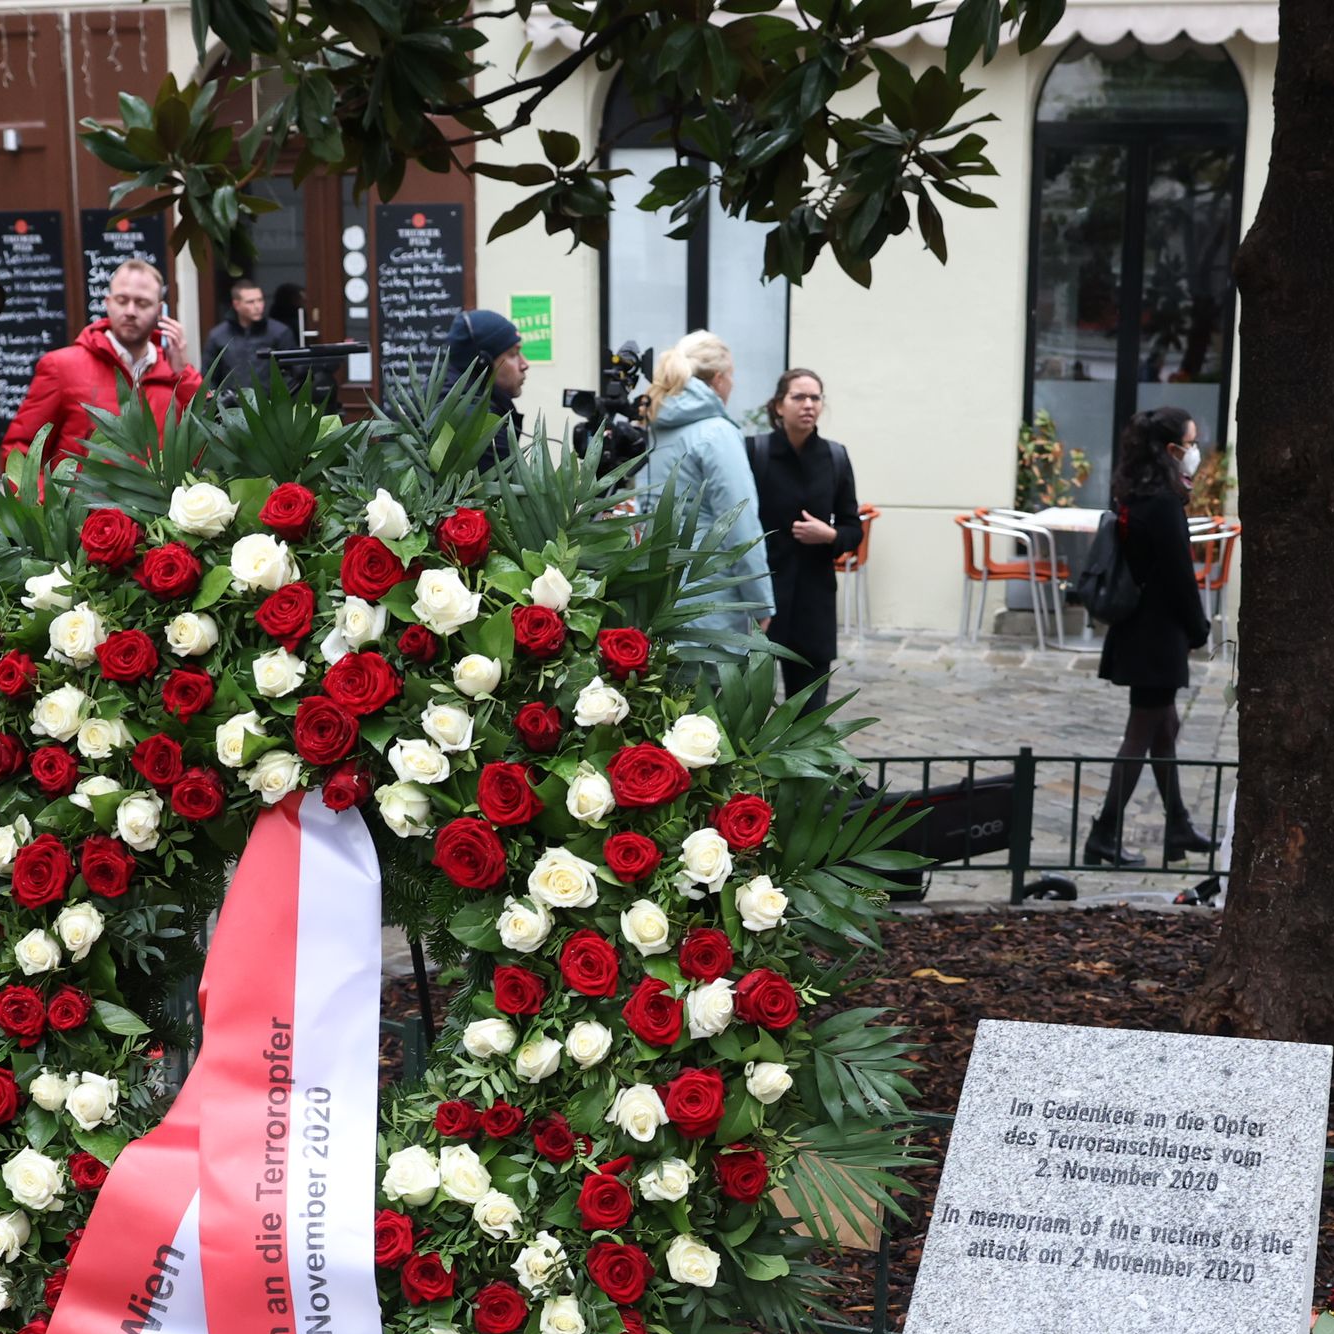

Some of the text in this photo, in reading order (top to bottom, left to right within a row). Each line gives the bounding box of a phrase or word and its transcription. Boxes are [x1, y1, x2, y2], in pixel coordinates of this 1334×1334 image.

[255, 1016, 295, 1202] Terroropfer
[302, 1086, 332, 1159] 2020
[1009, 1097, 1267, 1139] Im Gedenken an die Opfer
[1004, 1125, 1262, 1167] des Terroranschlages vom
[1035, 1158, 1218, 1192] 2. November 2020
[255, 1212, 283, 1263] die
[941, 1204, 1293, 1256] In memoriam of the victims of the
[967, 1239, 1255, 1284] attack on 2 November 2020
[264, 1275, 287, 1314] an
